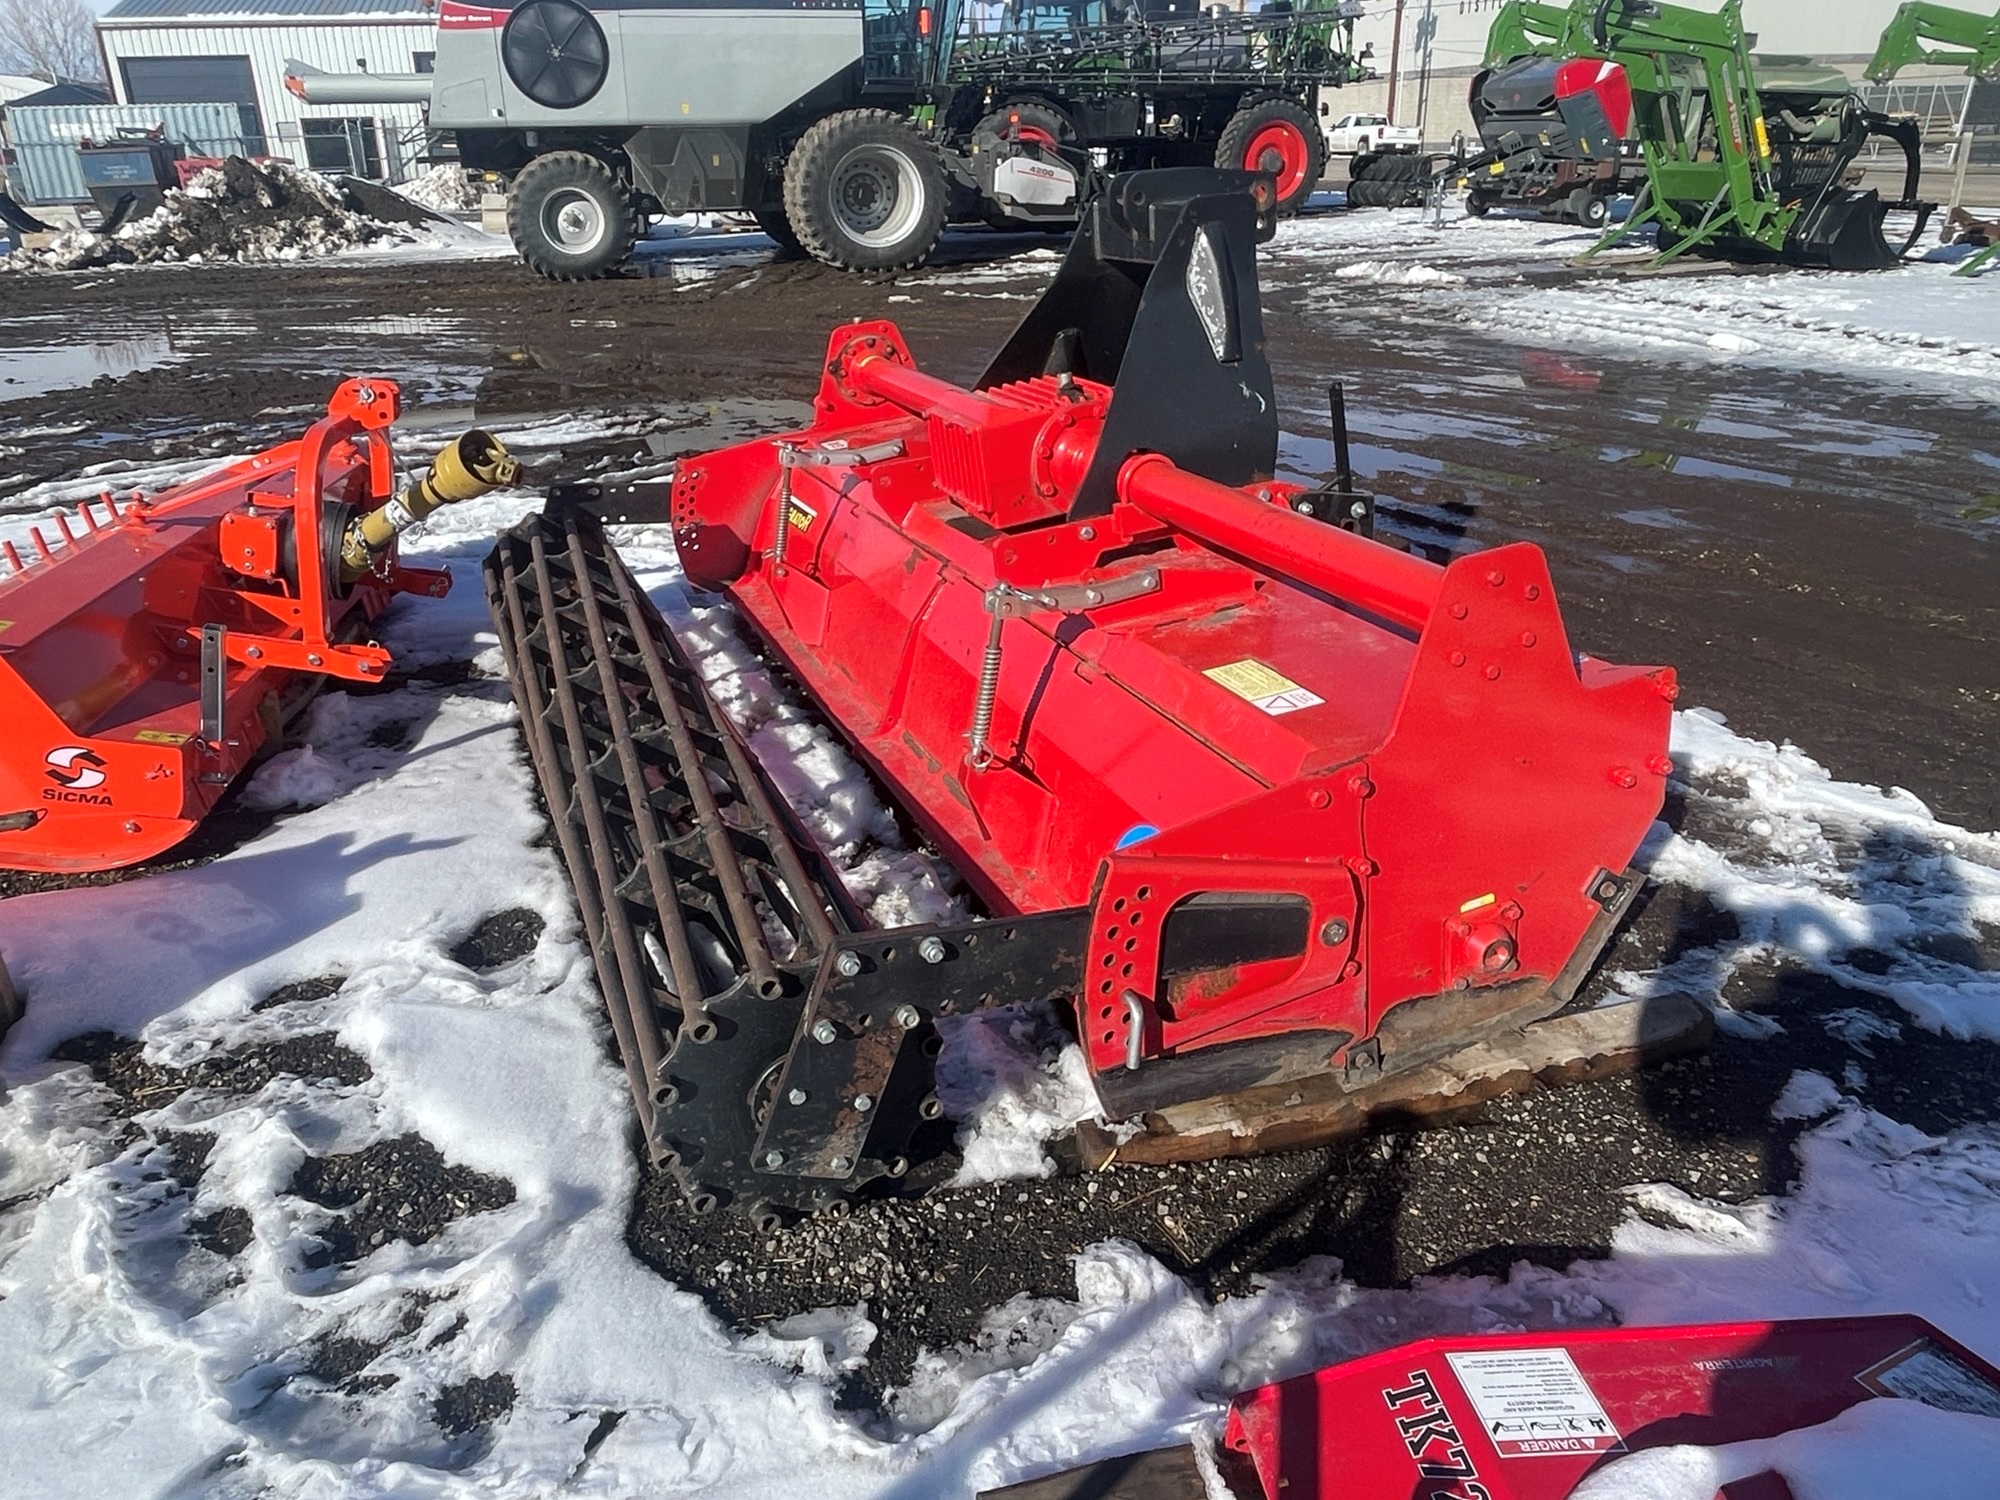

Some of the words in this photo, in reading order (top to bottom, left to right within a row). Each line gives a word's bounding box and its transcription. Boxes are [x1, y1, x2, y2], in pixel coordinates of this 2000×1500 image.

[1029, 166, 1055, 177] 4200
[42, 788, 113, 806] SICMA
[1693, 1358, 1773, 1371] AGRITERRA
[1516, 1438, 1581, 1452] DANGER
